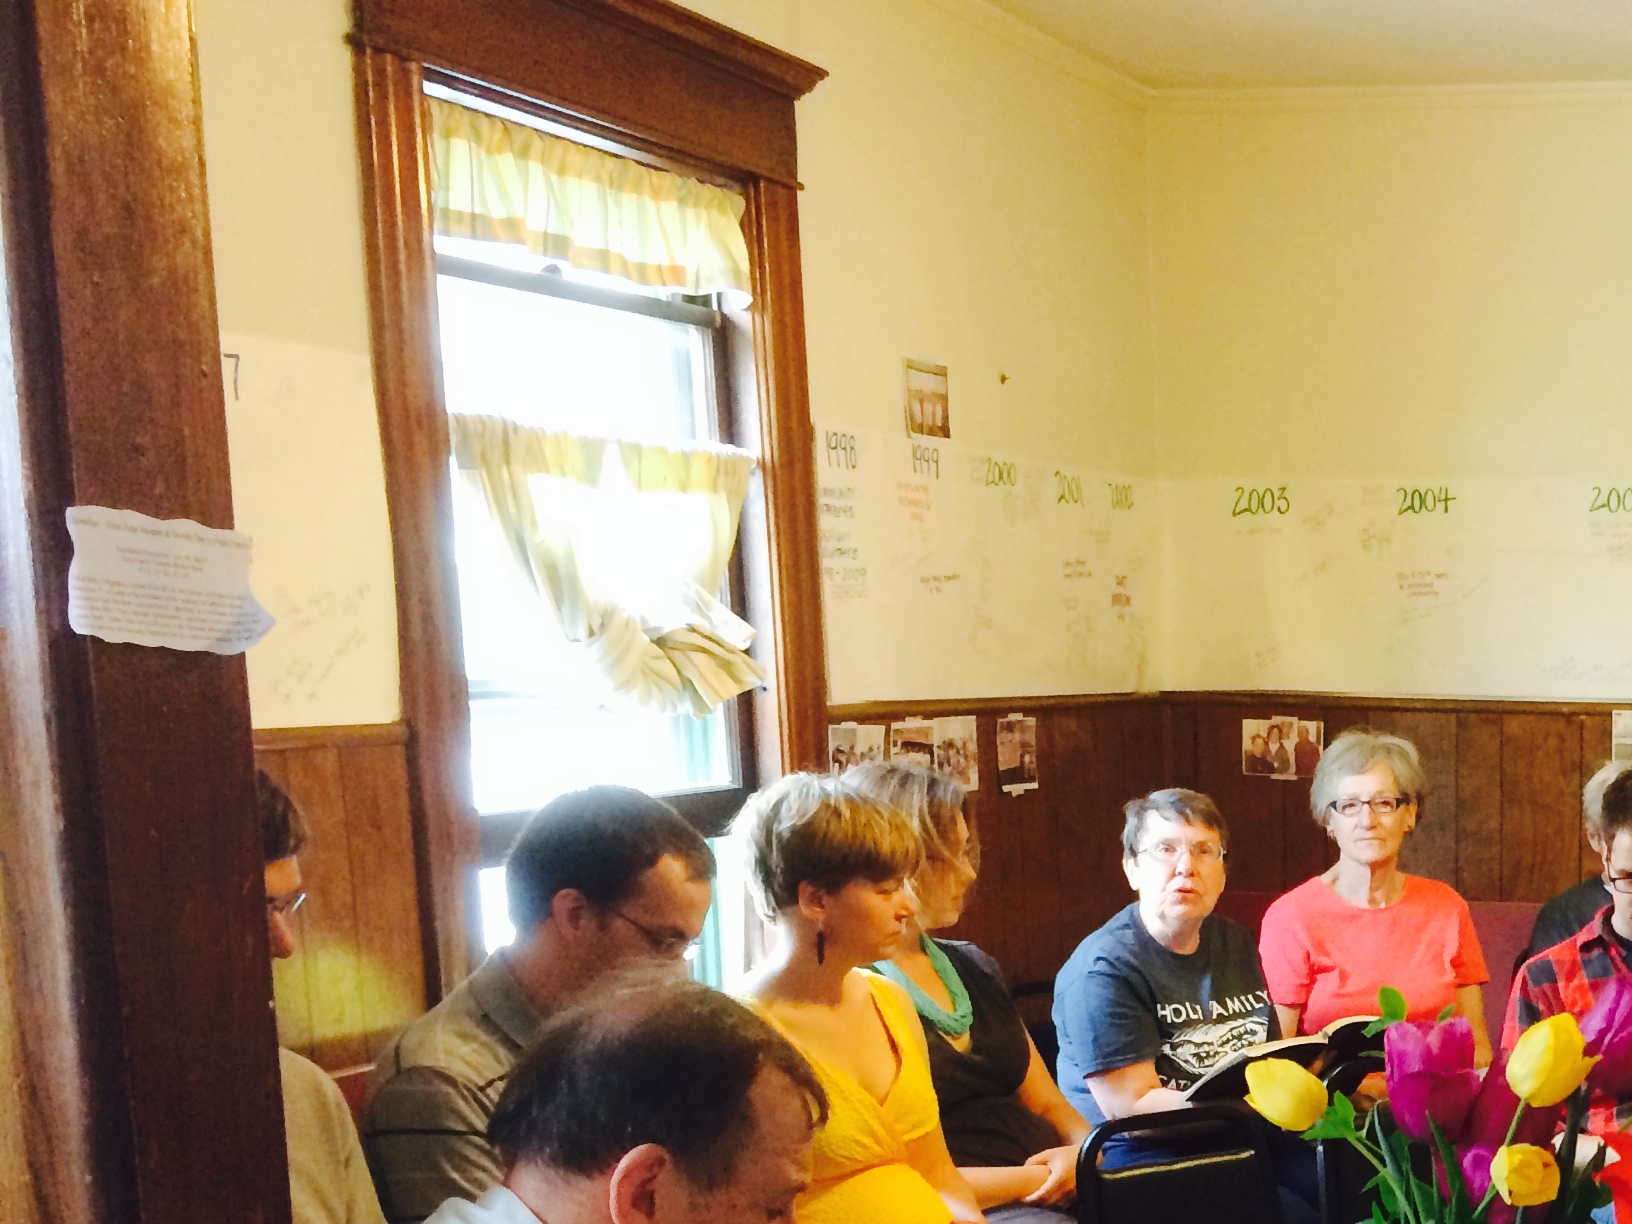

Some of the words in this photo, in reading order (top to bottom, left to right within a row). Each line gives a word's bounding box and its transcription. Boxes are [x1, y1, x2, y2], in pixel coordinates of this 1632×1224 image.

[826, 430, 857, 470] 1998
[911, 444, 939, 480] 1999
[985, 457, 1017, 487] 2000
[1054, 470, 1085, 508] 2001
[1232, 486, 1290, 517] 2003
[1396, 485, 1457, 516] 2004
